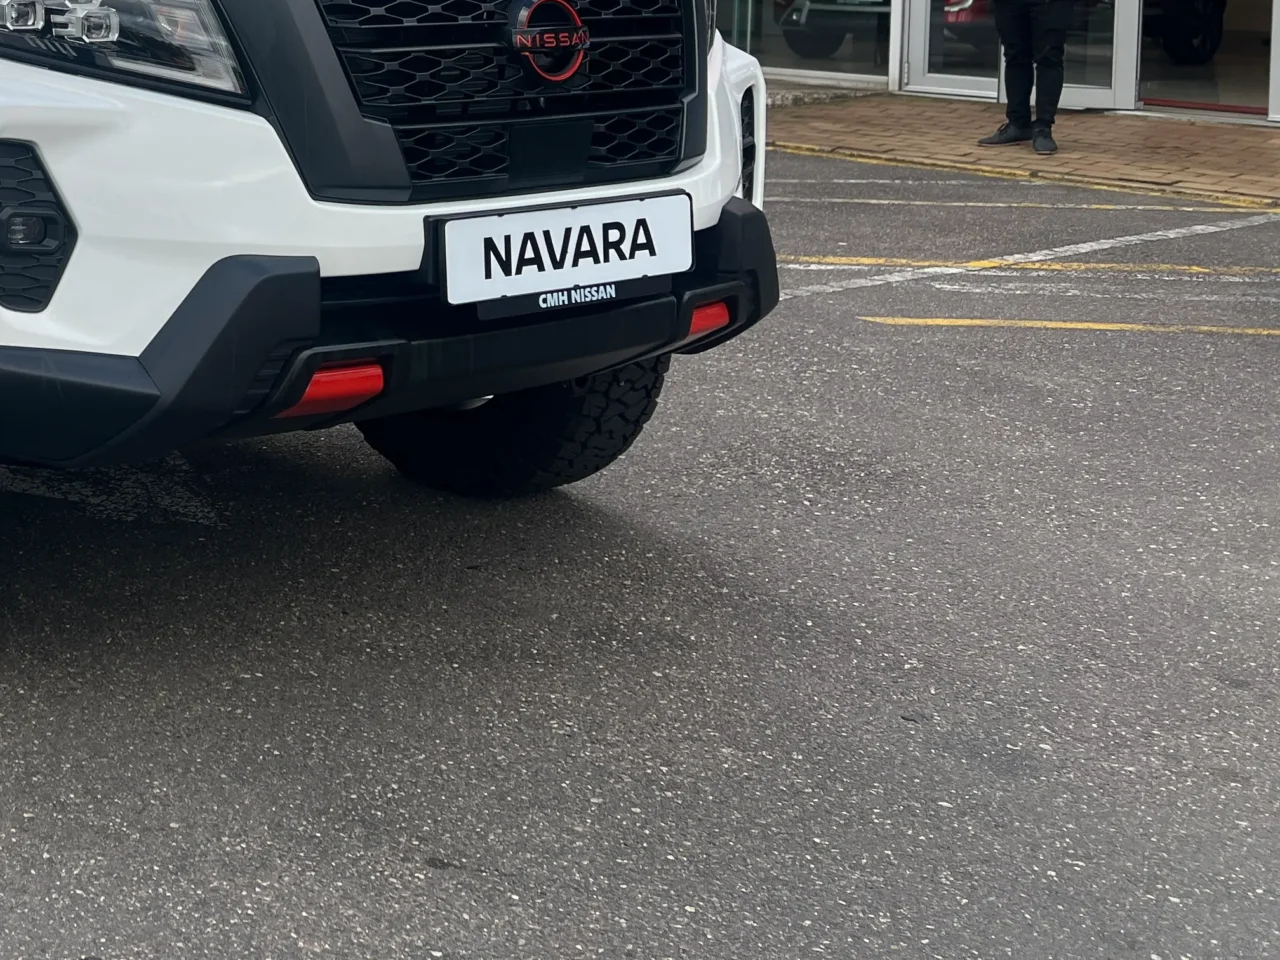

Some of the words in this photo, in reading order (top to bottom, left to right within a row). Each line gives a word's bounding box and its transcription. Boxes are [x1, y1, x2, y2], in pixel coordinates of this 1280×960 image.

[516, 32, 589, 48] NISSAN
[483, 217, 657, 280] NAVARA
[538, 290, 569, 309] CMH
[571, 284, 616, 304] NISSAN
